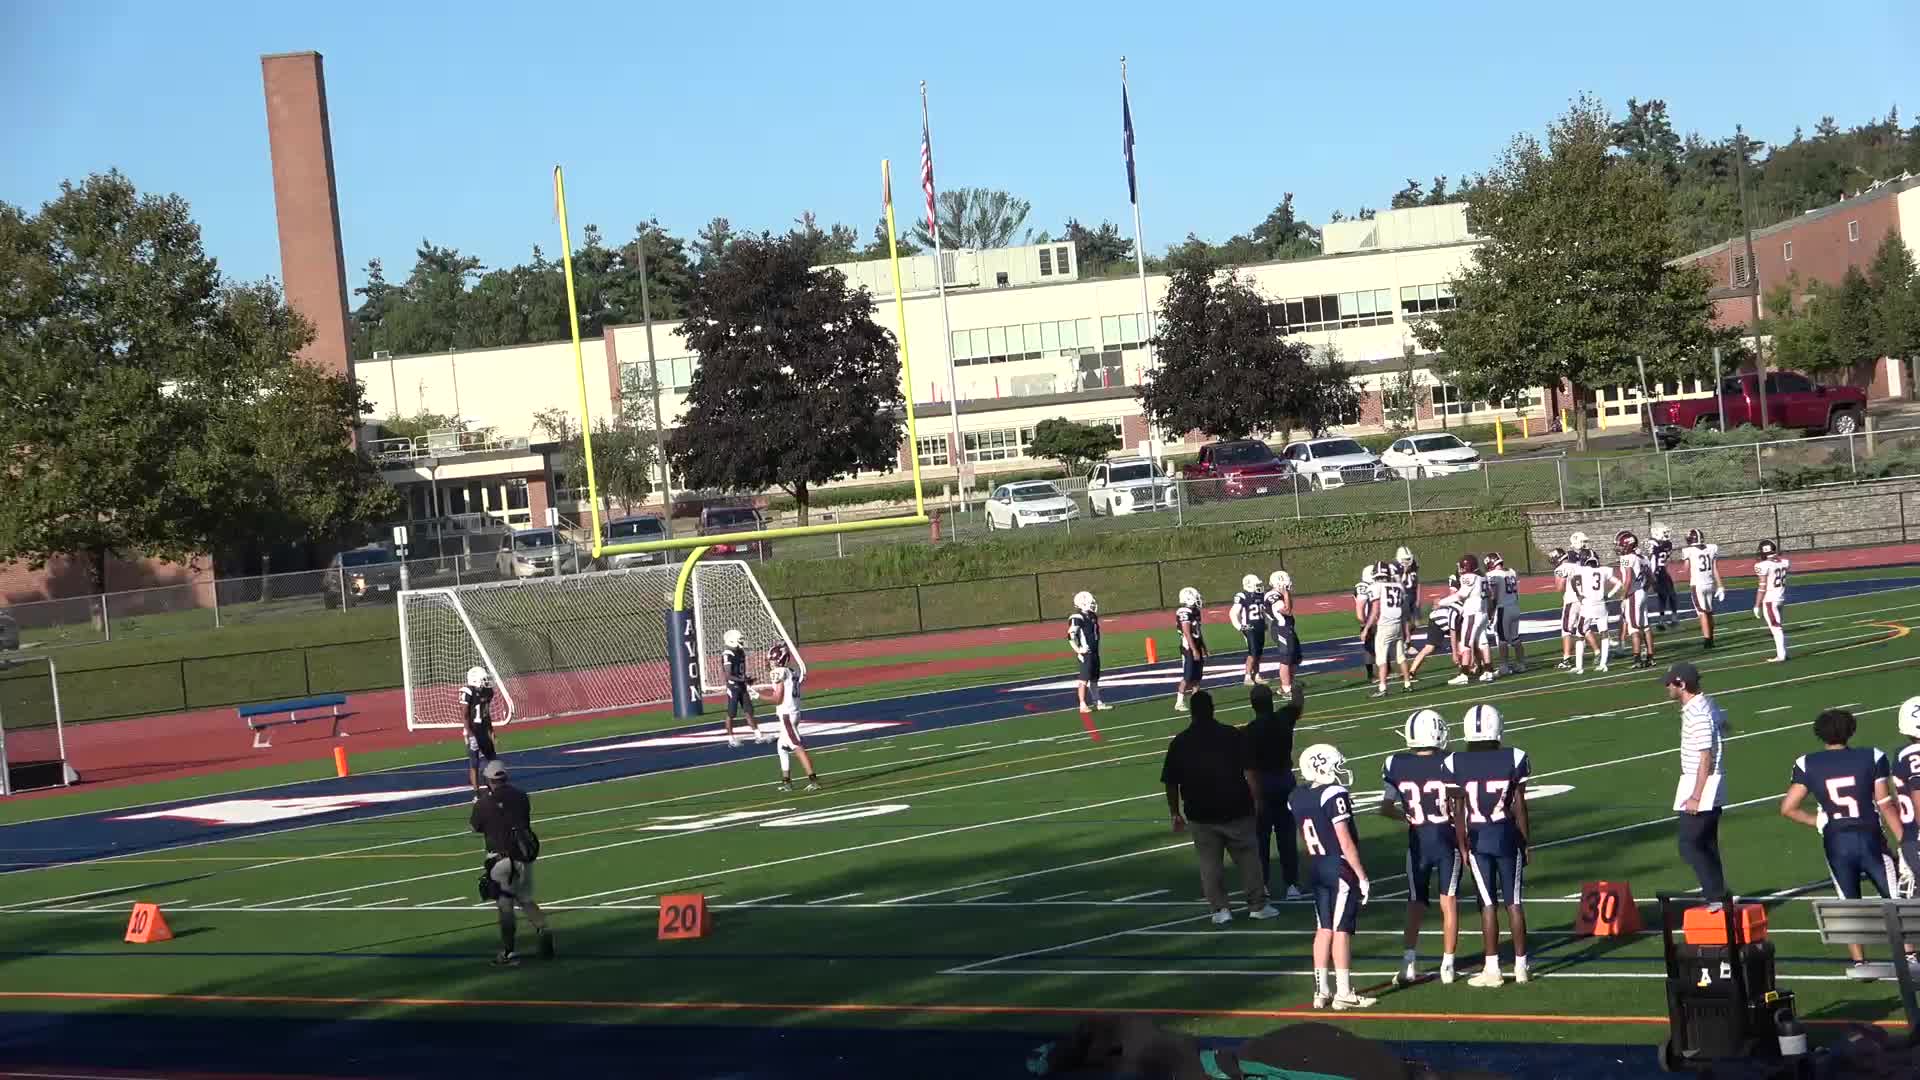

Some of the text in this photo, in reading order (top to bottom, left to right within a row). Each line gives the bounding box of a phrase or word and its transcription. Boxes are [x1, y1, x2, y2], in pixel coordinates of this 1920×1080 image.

[1592, 572, 1601, 591] 3
[684, 619, 701, 702] AVON
[1310, 753, 1328, 769] 25
[1336, 797, 1347, 814] 8
[1398, 781, 1449, 824] 33
[1465, 781, 1511, 824] 17
[1825, 776, 1859, 820] 5
[131, 910, 148, 934] 10
[664, 903, 696, 934] 20
[1583, 889, 1619, 923] 30
